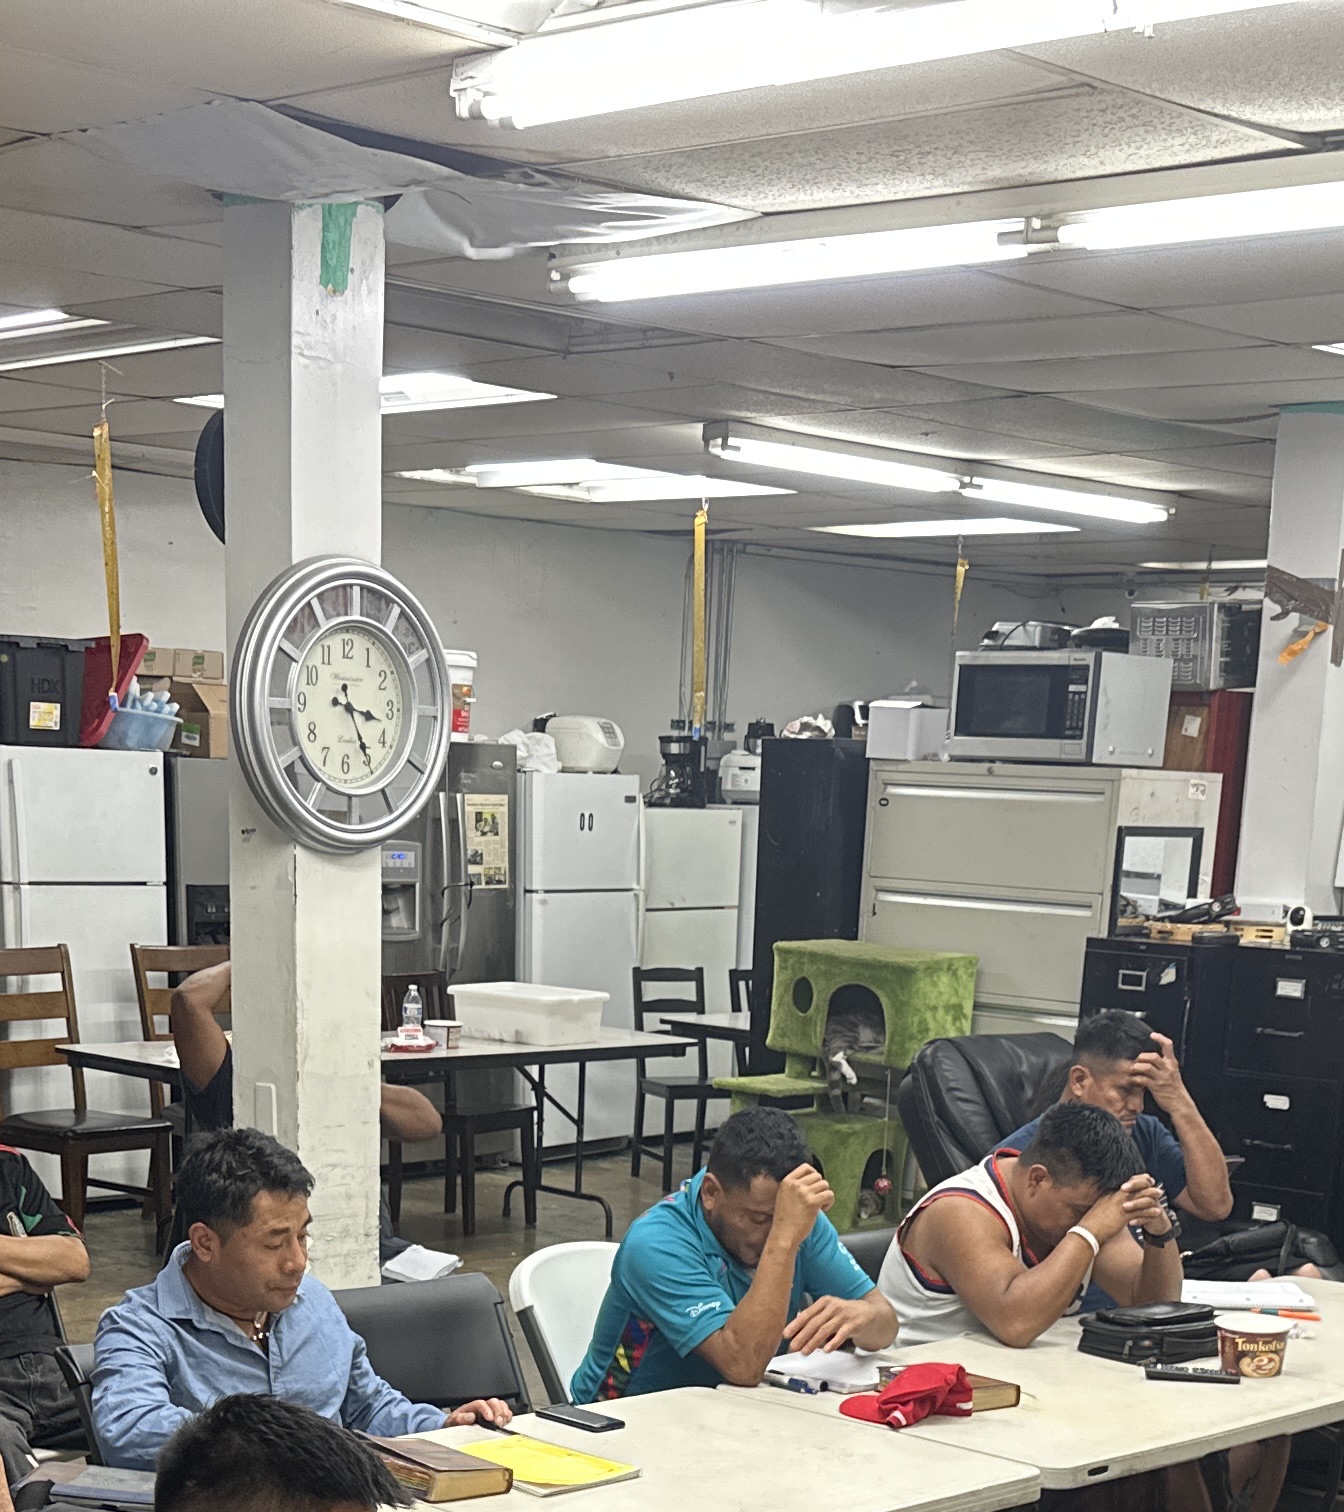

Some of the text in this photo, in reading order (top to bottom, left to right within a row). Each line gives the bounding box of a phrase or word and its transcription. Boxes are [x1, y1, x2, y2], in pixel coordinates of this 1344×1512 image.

[320, 643, 332, 666] 11
[341, 638, 355, 660] 12
[365, 647, 372, 668] 1
[306, 664, 319, 687] 10
[378, 669, 387, 691] 2
[297, 691, 307, 713] 9
[385, 699, 395, 721] 3
[307, 721, 317, 743] 8
[378, 727, 387, 748] 4
[321, 746, 330, 767] 7
[341, 753, 350, 775] 6
